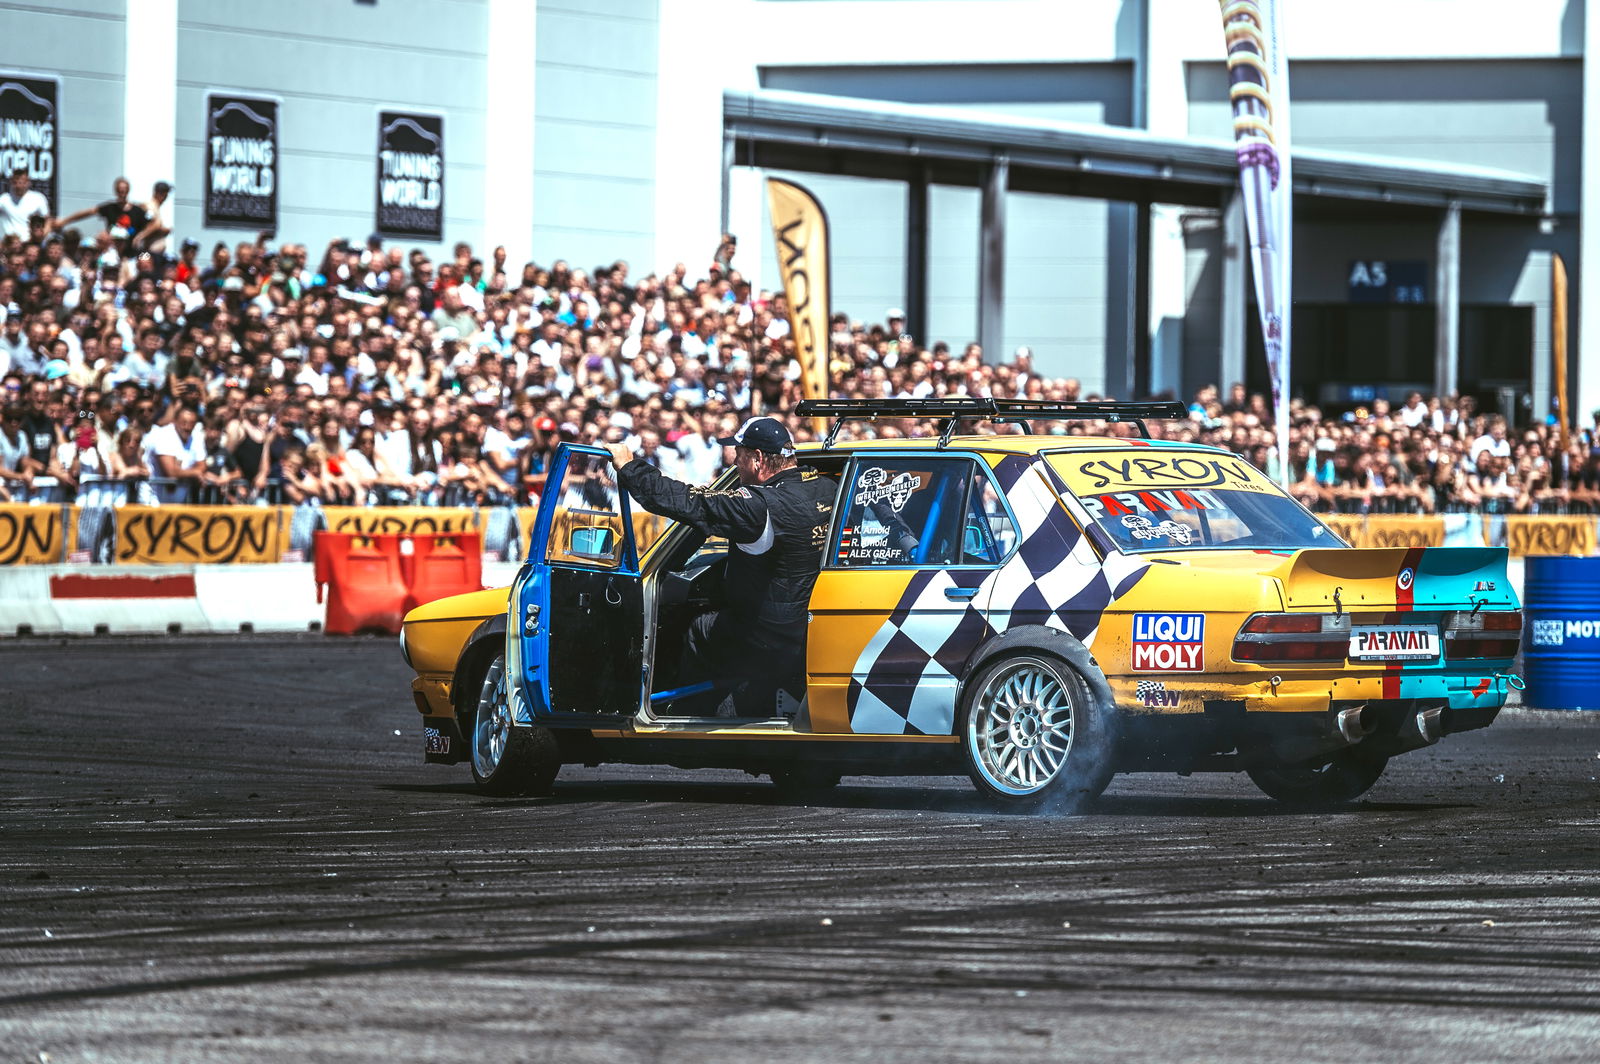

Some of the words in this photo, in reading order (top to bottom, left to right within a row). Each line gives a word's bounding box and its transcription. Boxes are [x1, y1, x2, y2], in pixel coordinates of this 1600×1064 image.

[210, 136, 275, 166] TUNING
[380, 151, 441, 179] TUNING
[210, 164, 275, 196] WORLD
[380, 179, 441, 210] WORLD
[1080, 458, 1251, 487] SYRON
[1083, 490, 1226, 518] PARAVAN
[120, 513, 274, 564] SYRON
[864, 525, 890, 535] Arnold
[1512, 522, 1586, 555] SYRON
[849, 550, 871, 558] ALEX
[873, 547, 901, 558] GRÄFF
[1473, 581, 1496, 591] M5
[1136, 616, 1201, 642] LIQUI
[1358, 631, 1430, 651] PARAVAN
[1136, 644, 1201, 669] MOLY
[1143, 690, 1181, 708] KW
